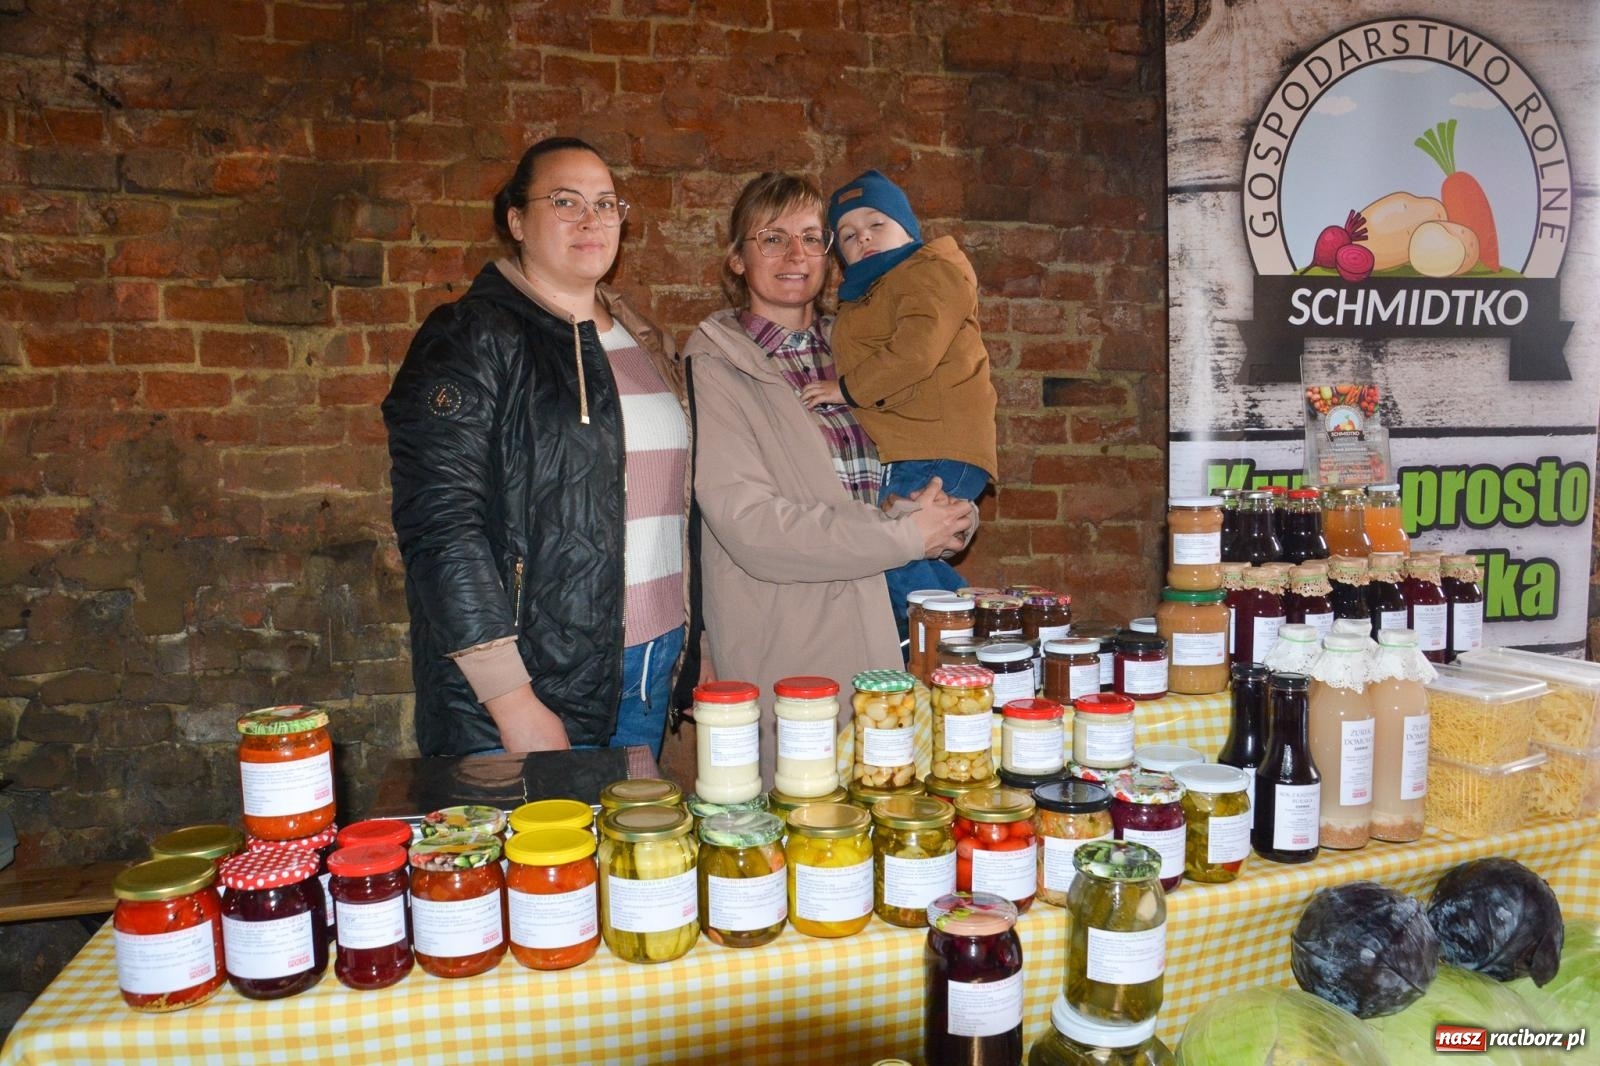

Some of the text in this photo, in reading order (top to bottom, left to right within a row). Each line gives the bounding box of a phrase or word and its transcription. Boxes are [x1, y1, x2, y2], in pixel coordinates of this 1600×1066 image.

[1248, 24, 1568, 243] GOSPODARSTWO ROLNE
[1288, 287, 1529, 327] SCHMIDTKO
[1401, 461, 1589, 534] prosto
